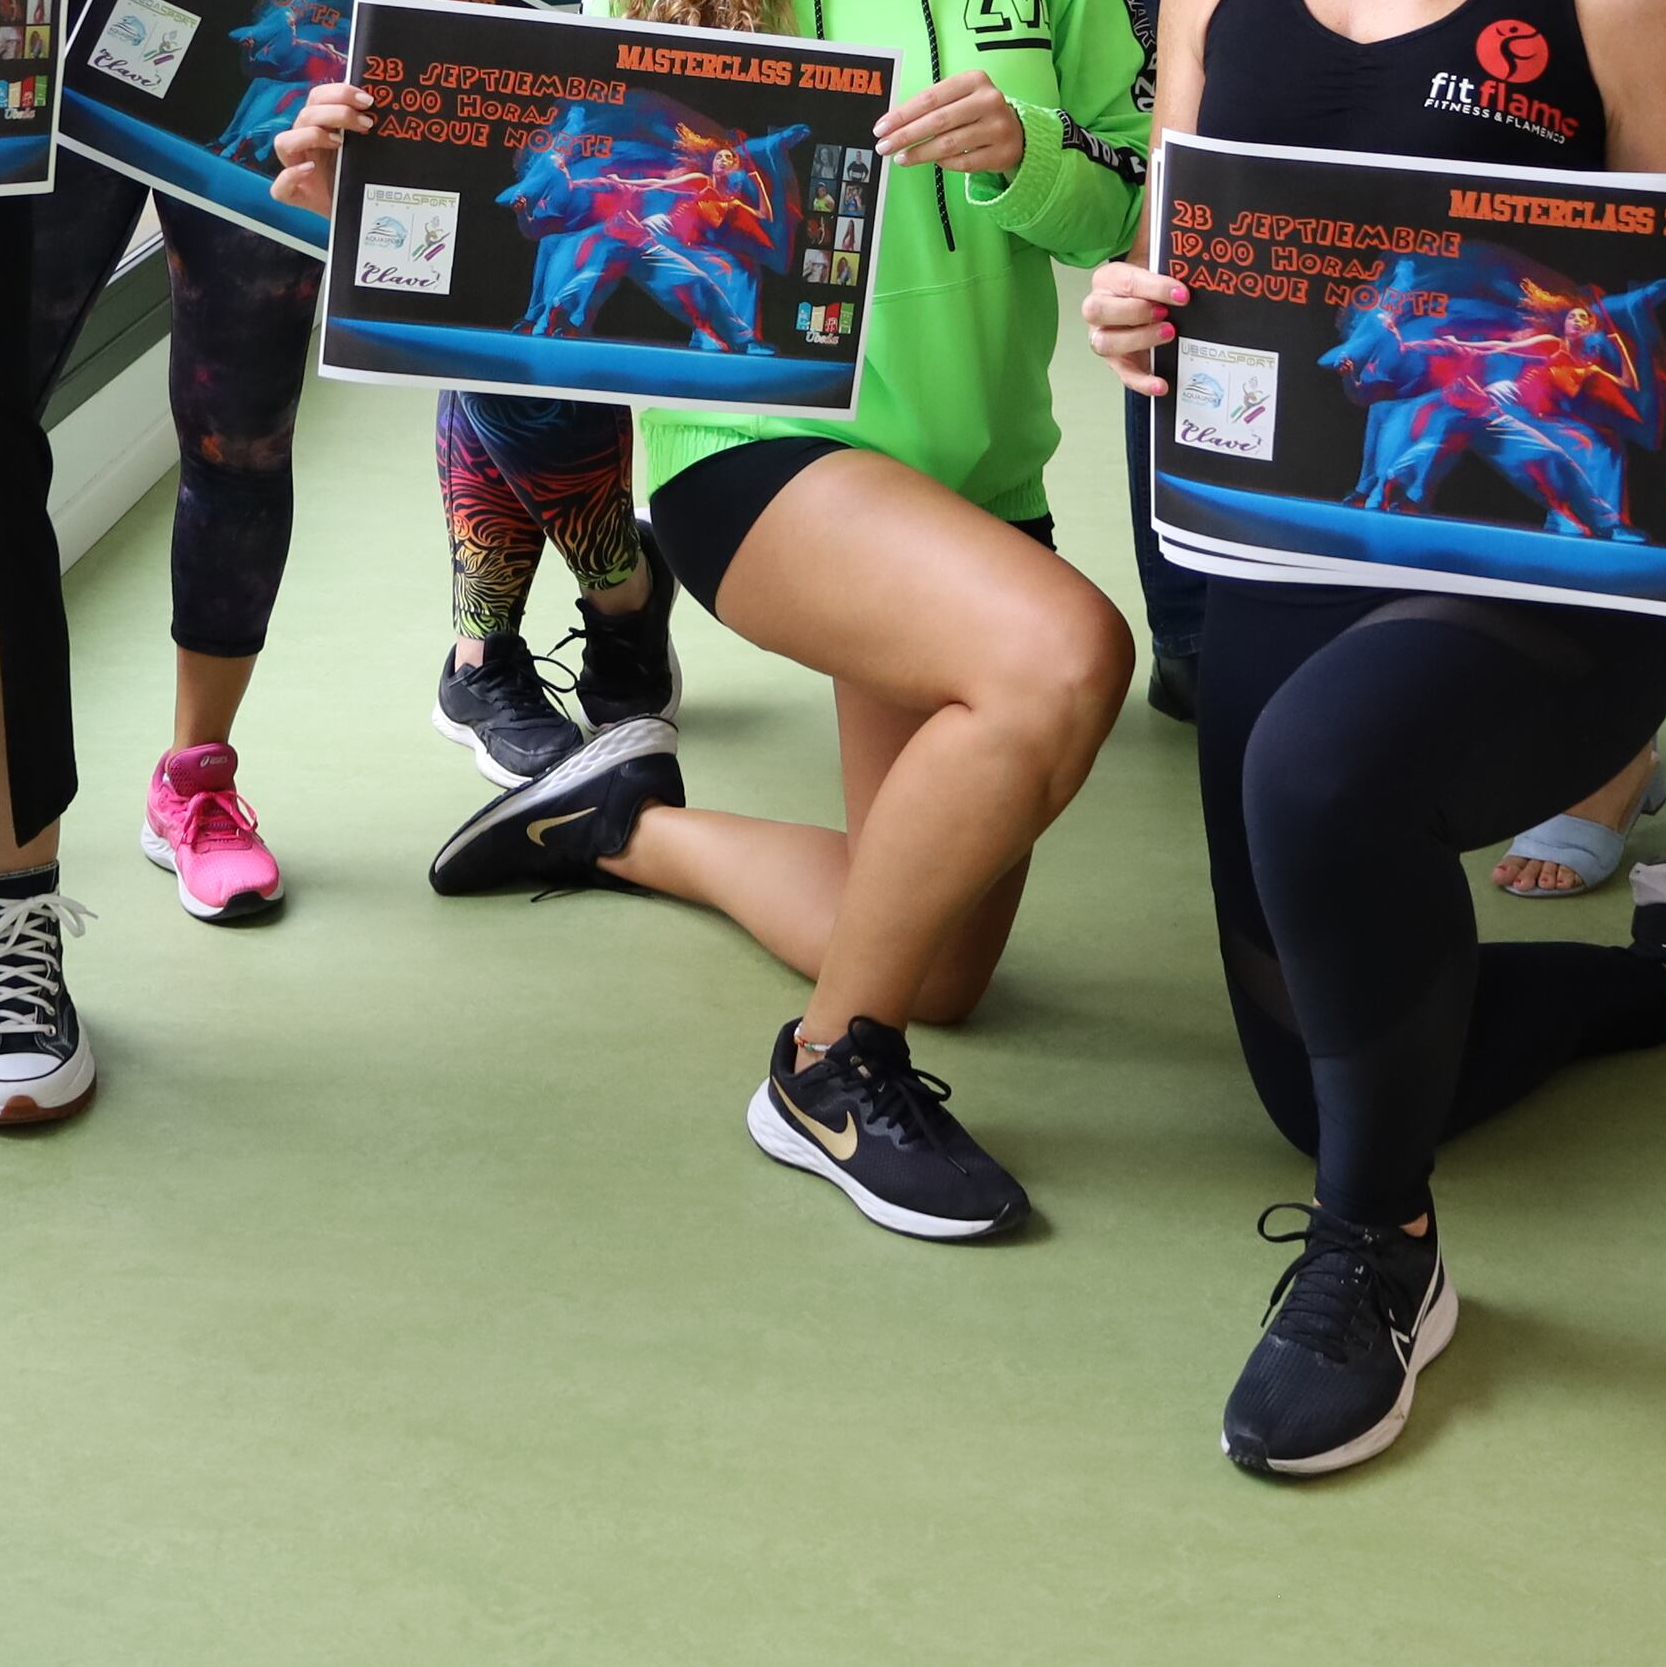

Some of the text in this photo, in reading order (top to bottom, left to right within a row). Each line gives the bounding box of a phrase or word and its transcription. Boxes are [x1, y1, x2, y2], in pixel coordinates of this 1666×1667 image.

[363, 56, 627, 106] 23 SEPTIEMBRE
[616, 43, 883, 97] MASTERCLASS ZUMBA
[1429, 72, 1475, 104] fit
[457, 94, 558, 125] HORAS
[1424, 98, 1490, 119] FITNESS
[1493, 111, 1503, 123] &
[366, 111, 613, 158] ARQUE NORTE
[1172, 200, 1461, 258] 23 SEPTIEMBRE
[1449, 189, 1655, 235] MASTERCLASS
[1170, 230, 1386, 281] 19.00 HORAS
[1168, 259, 1449, 319] PARQUE NORTE
